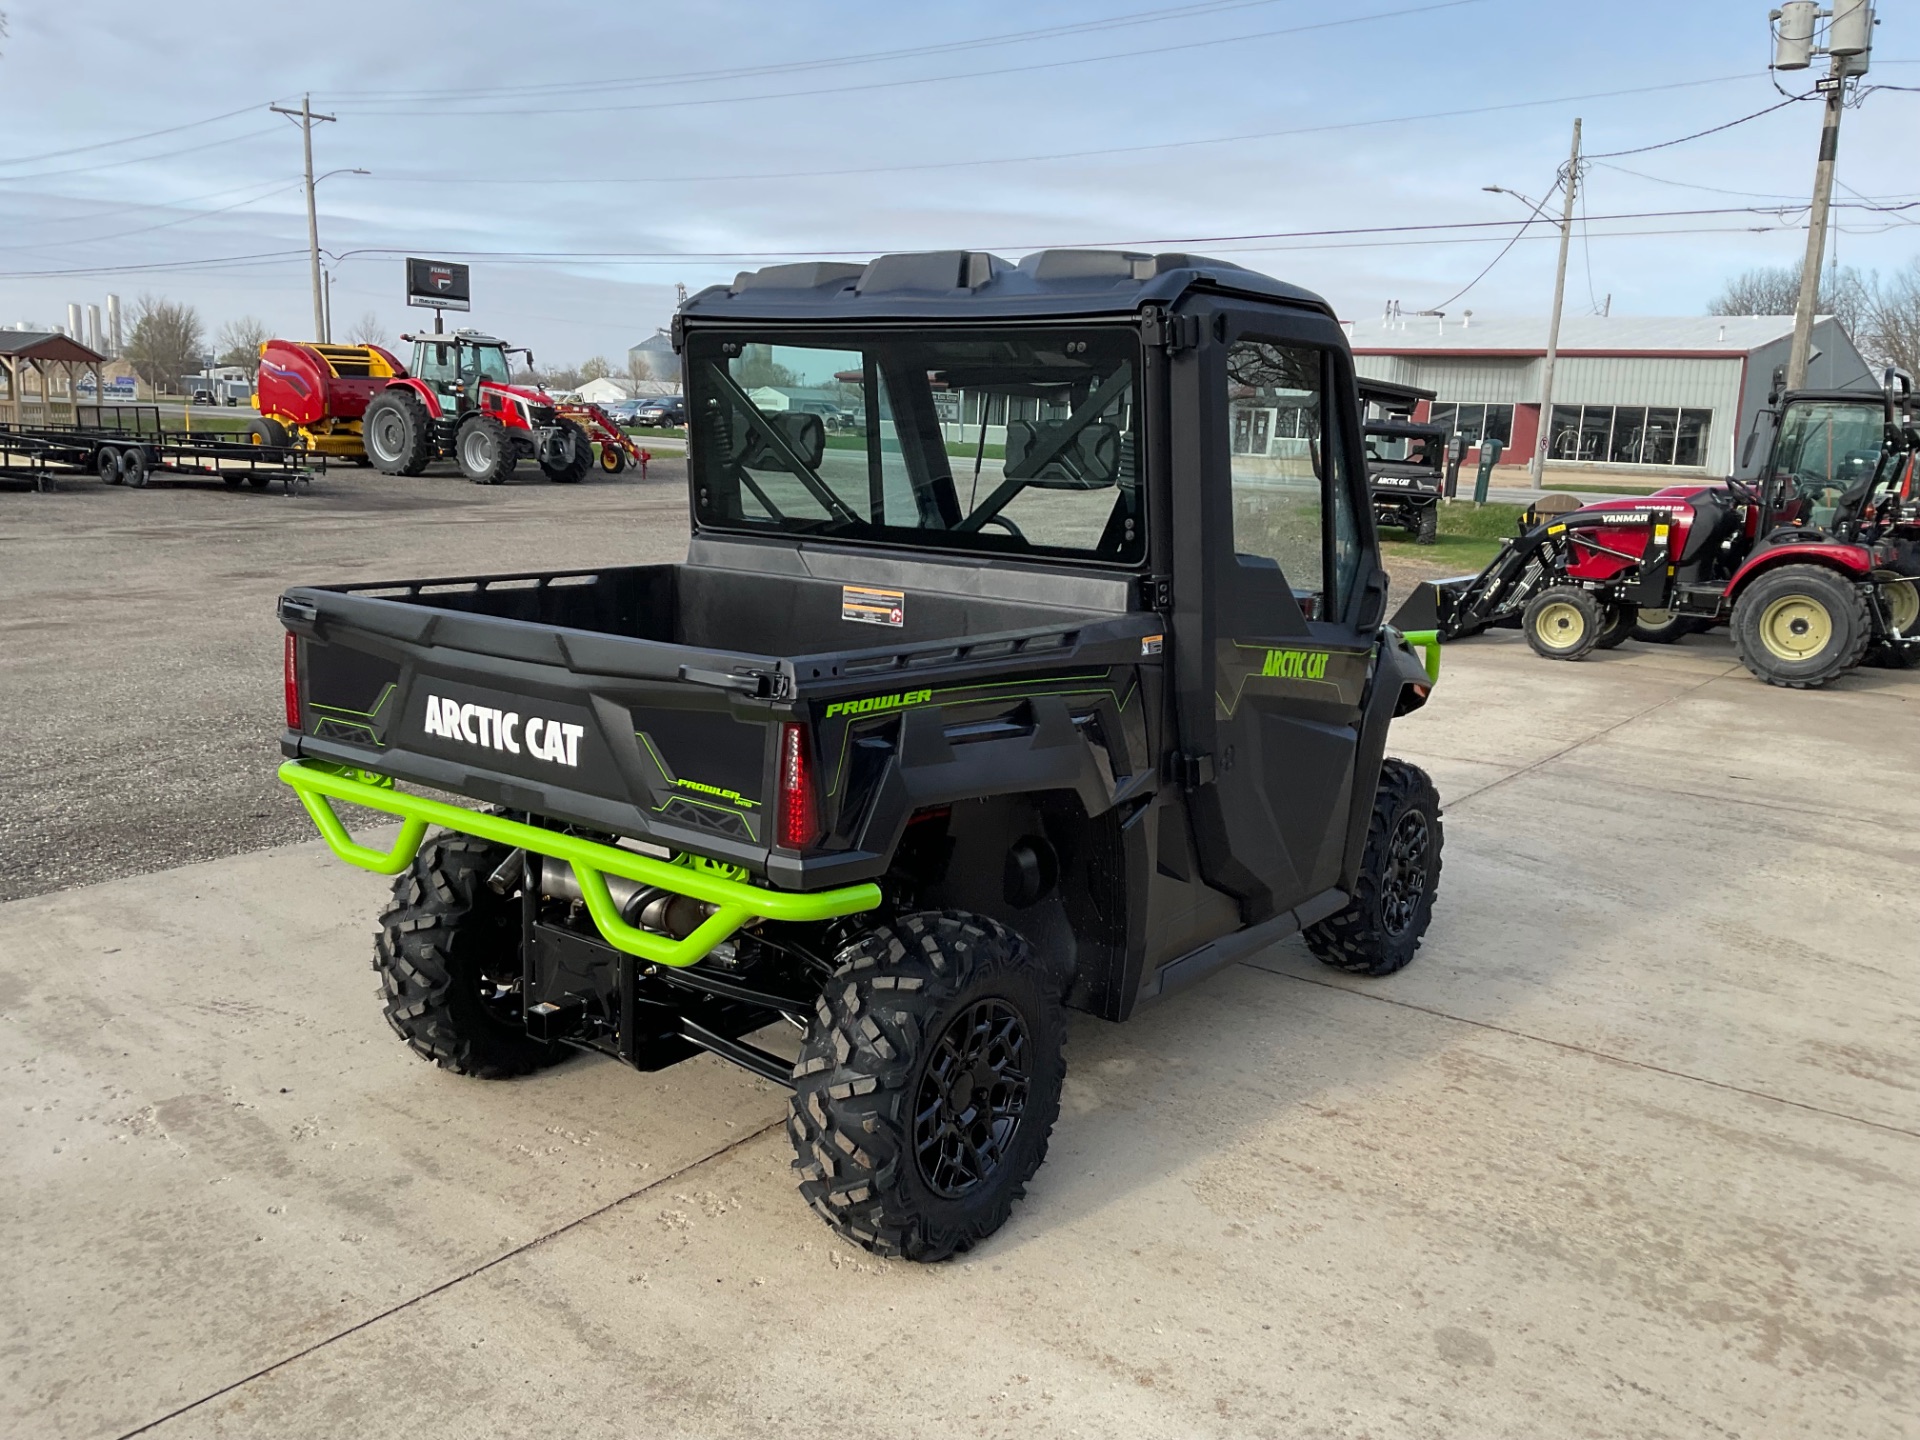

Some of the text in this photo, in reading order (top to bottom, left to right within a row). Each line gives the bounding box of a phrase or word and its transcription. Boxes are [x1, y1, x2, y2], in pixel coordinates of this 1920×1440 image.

[1377, 477, 1399, 485] ARCTIC
[1602, 514, 1648, 523] YANMAR
[1262, 650, 1329, 679] ARCTIC CAT
[826, 689, 932, 718] PROWLER
[424, 694, 584, 767] ARCTIC CAT
[677, 778, 741, 800] PROWLER
